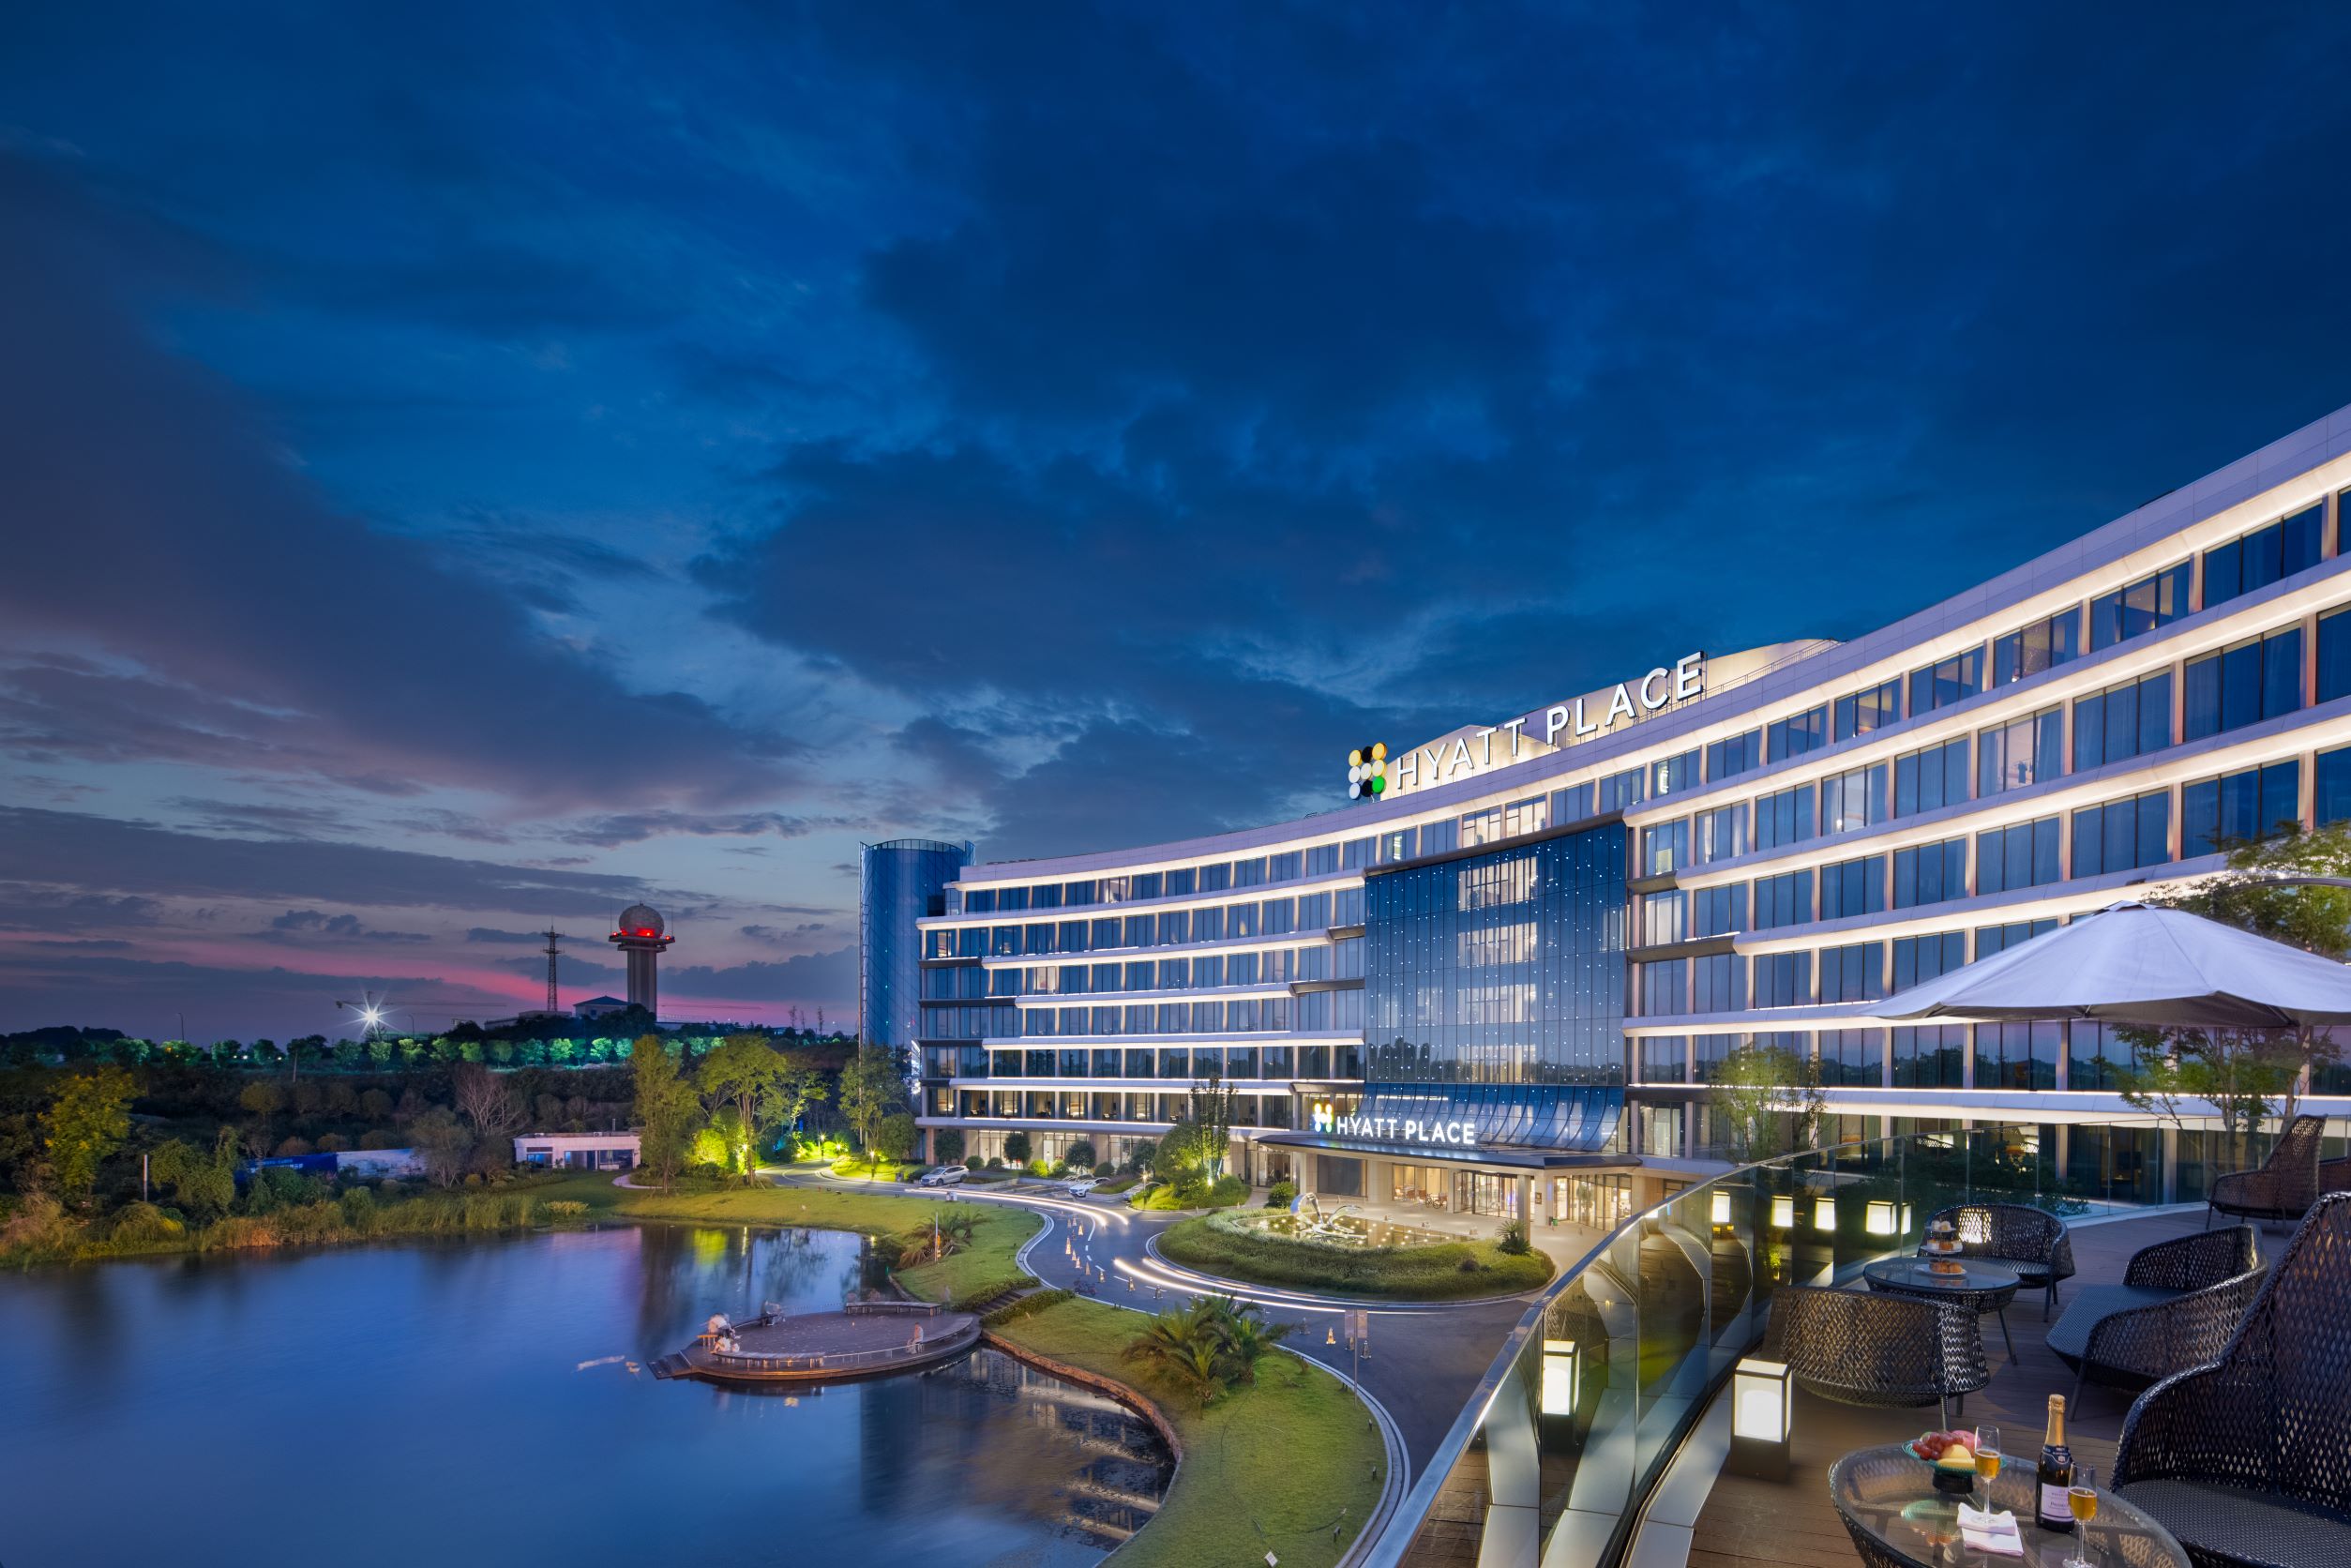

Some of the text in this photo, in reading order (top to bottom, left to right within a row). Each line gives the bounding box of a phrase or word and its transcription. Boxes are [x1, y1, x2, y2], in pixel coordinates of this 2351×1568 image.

[1396, 651, 1705, 789] HYATT PLACE
[1336, 1116, 1476, 1144] HYATT PLACE
